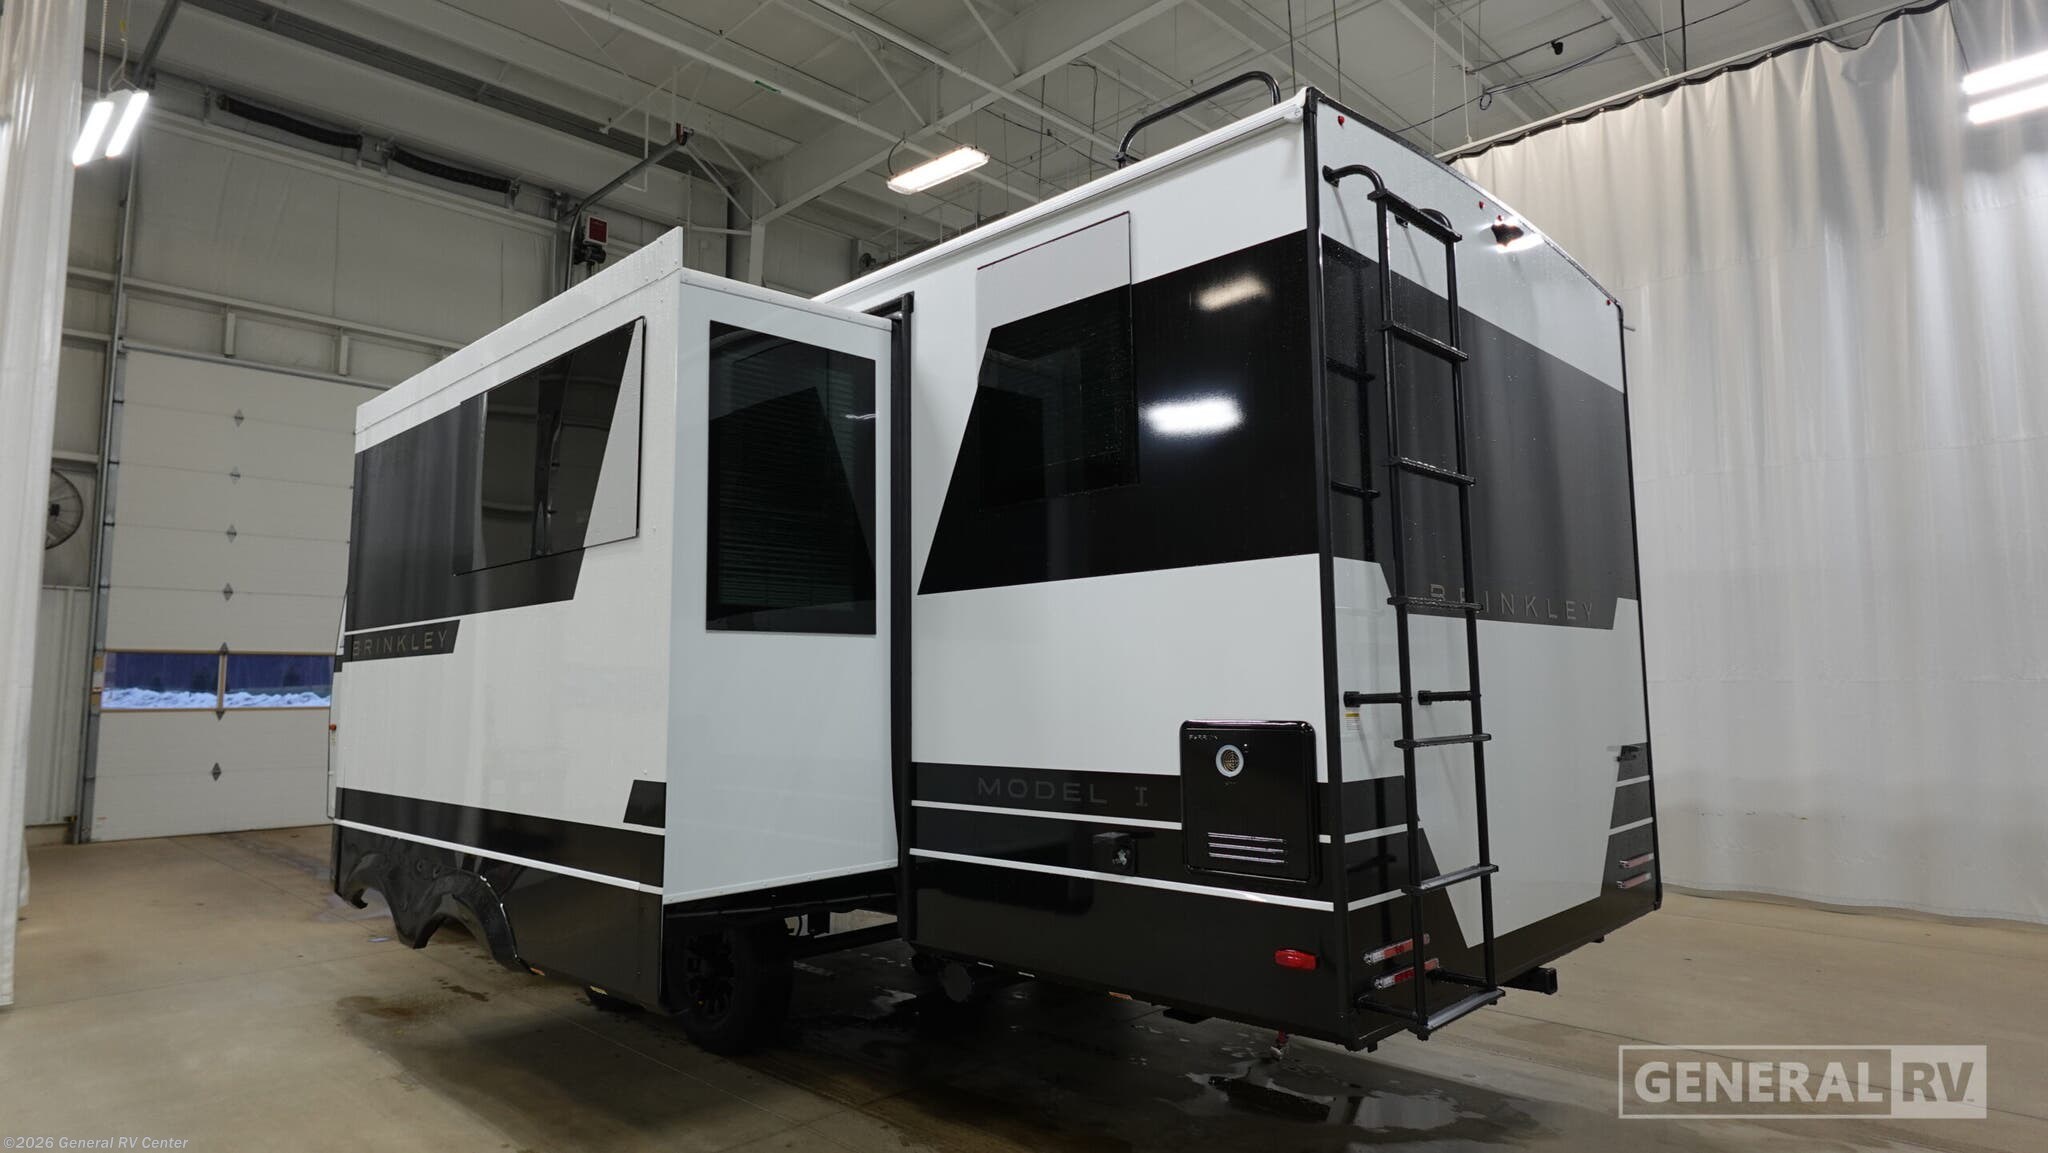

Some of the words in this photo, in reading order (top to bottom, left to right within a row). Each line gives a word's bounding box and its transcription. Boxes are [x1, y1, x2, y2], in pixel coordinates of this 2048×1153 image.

[352, 630, 448, 656] BRINKLEY
[977, 777, 1107, 804] MODEL
[1135, 786, 1148, 807] I
